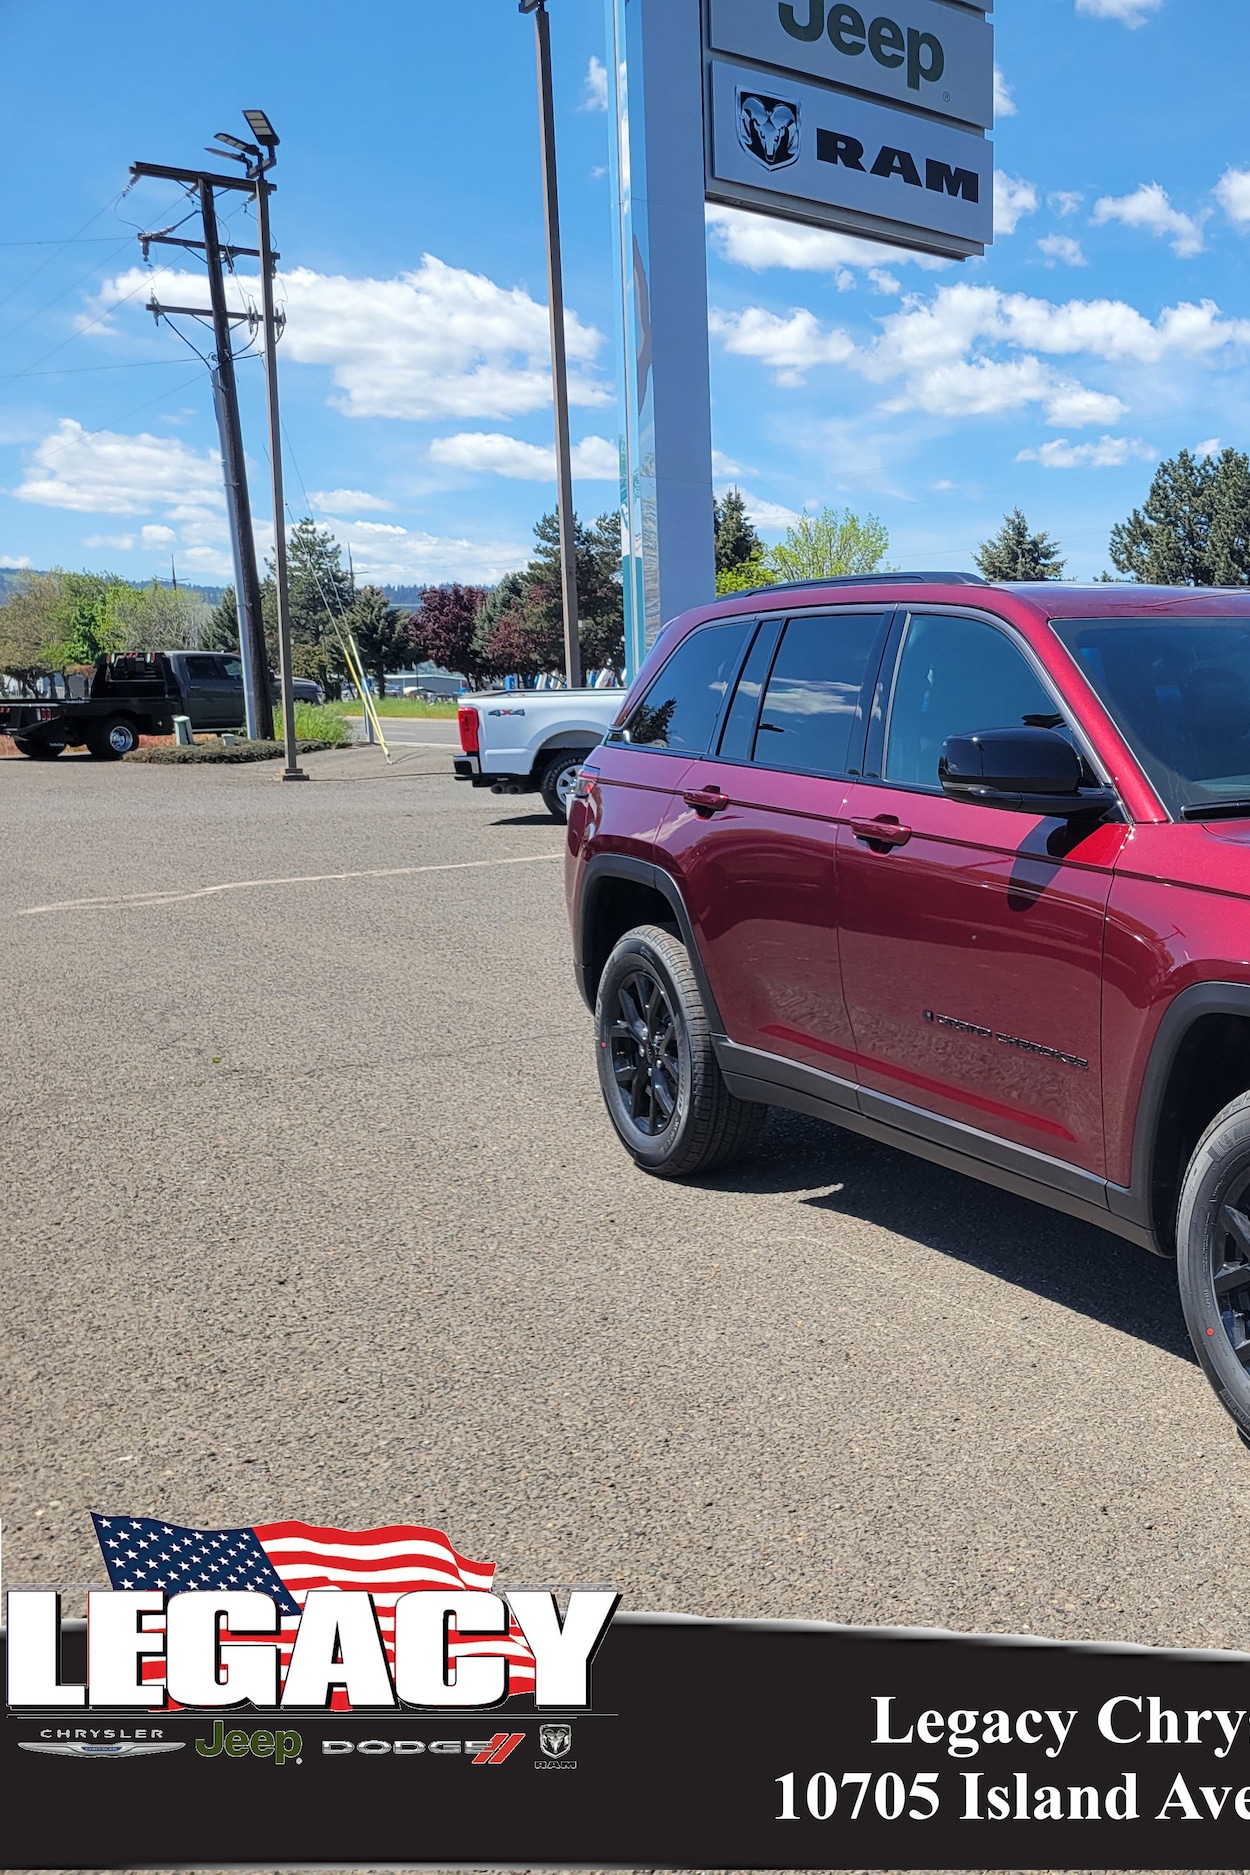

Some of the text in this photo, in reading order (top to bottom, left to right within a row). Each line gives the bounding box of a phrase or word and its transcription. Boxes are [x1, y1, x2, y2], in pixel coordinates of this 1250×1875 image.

[778, 1, 945, 91] Jeep
[816, 127, 979, 204] RAM
[936, 1013, 1089, 1070] GRAND CHEROKEE
